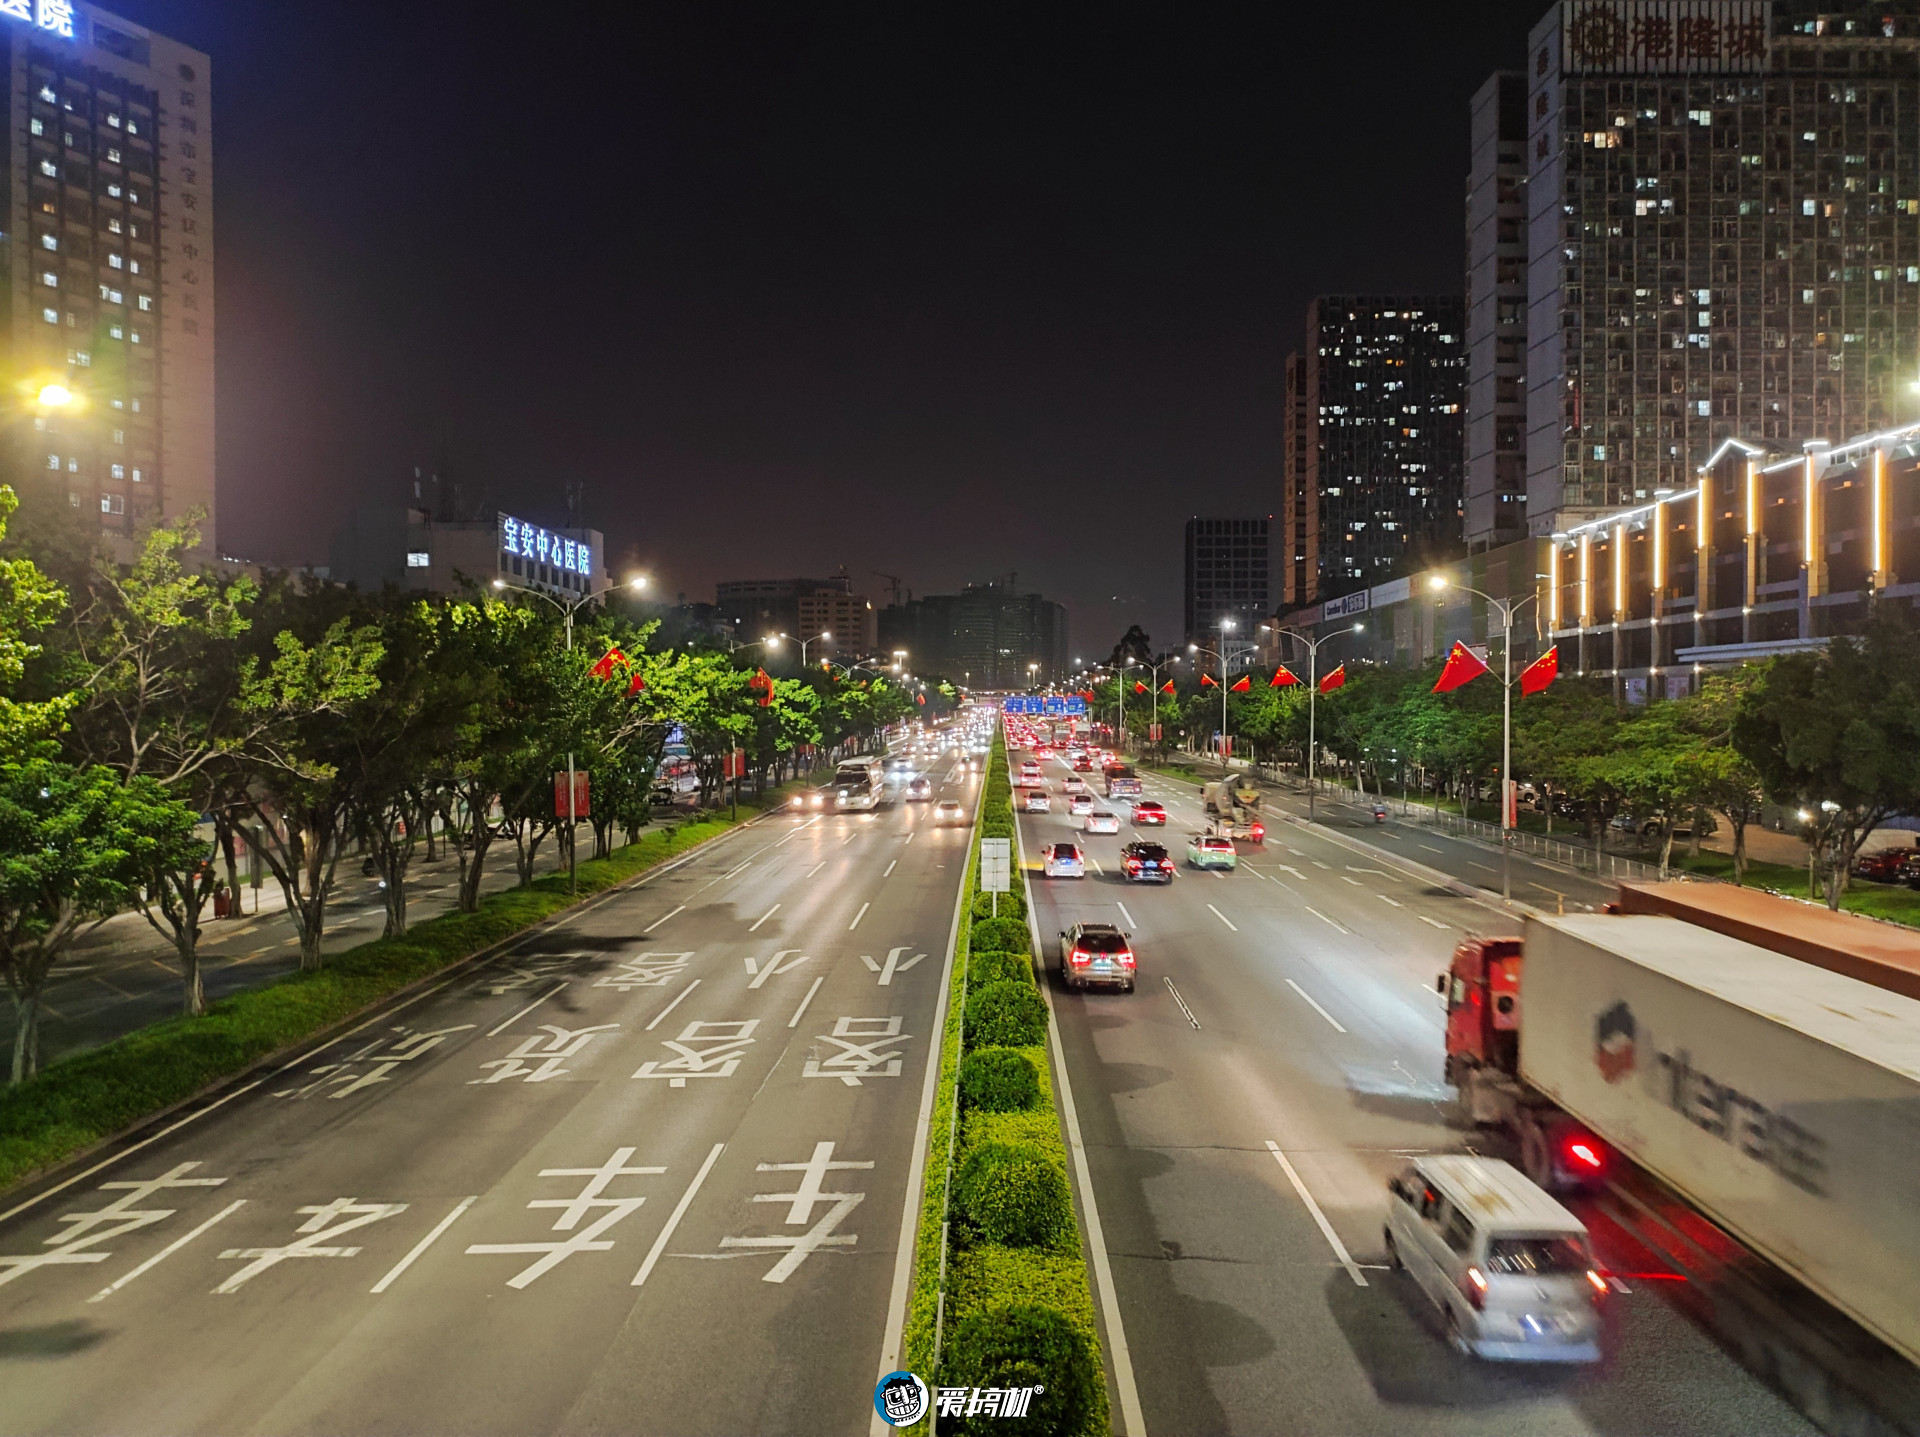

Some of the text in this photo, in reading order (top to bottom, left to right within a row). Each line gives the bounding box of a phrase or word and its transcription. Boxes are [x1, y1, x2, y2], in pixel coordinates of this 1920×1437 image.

[1630, 15, 1768, 59] 港隆城
[503, 516, 591, 576] 宝安中心医院
